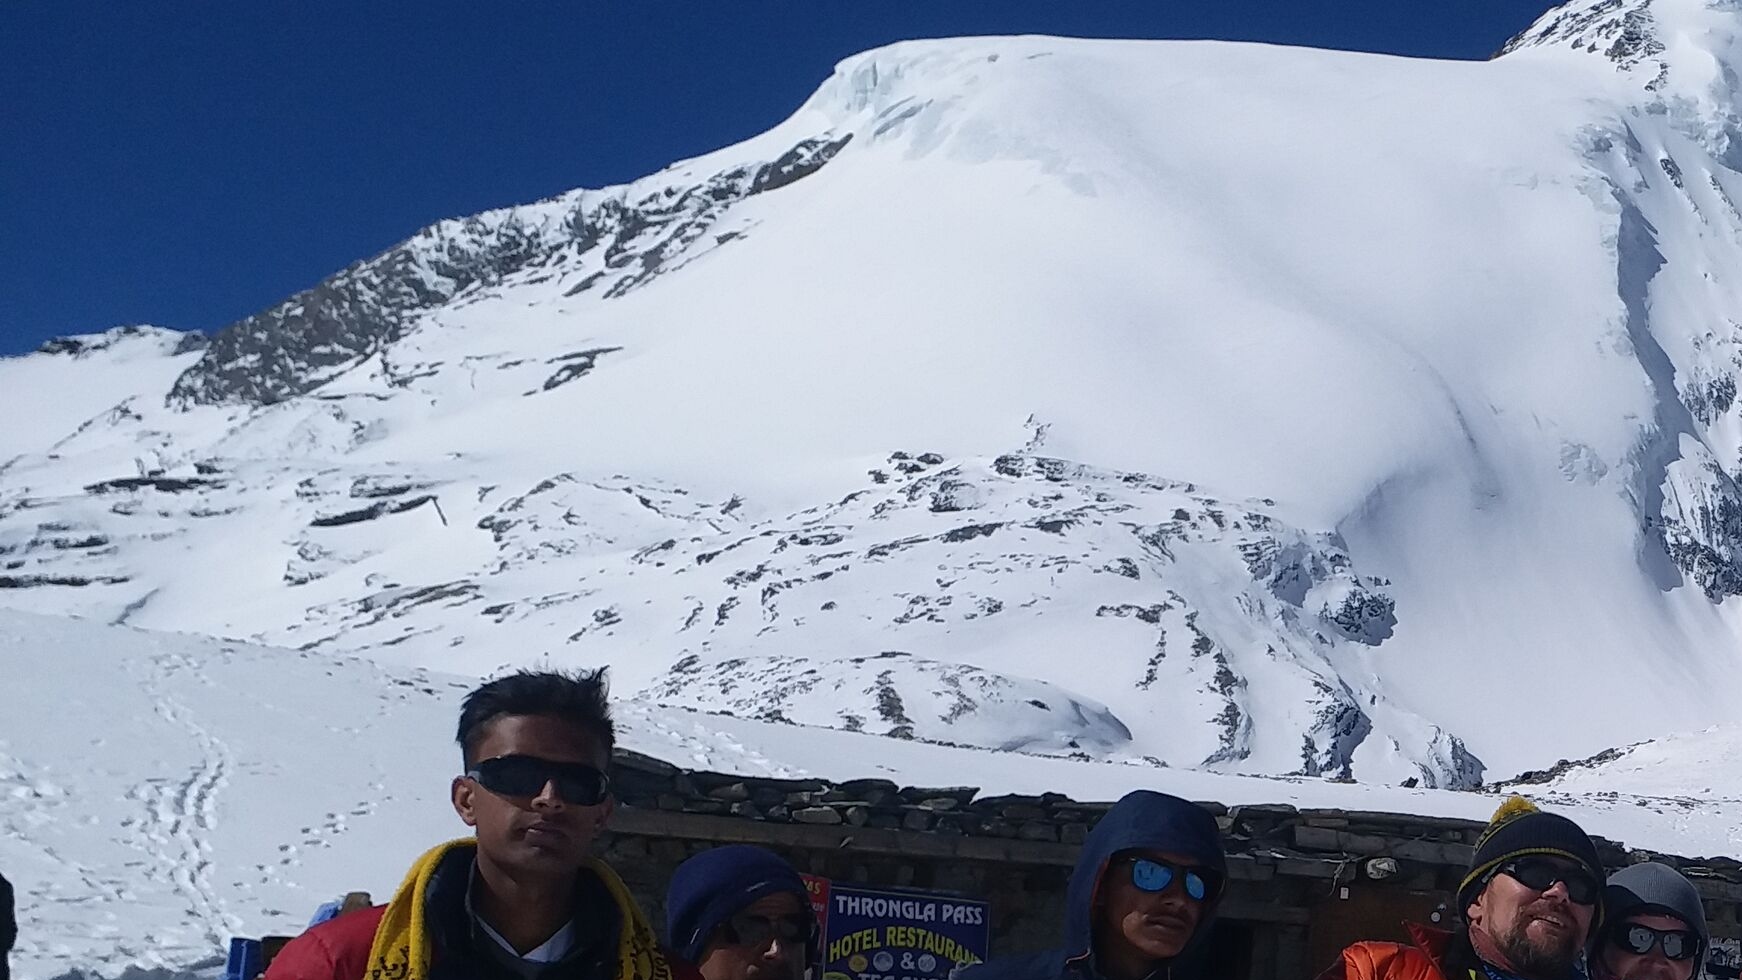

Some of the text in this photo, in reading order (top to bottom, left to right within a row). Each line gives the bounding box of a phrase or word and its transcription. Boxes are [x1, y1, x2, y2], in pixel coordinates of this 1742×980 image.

[835, 895, 936, 923] THRONGLA
[942, 903, 983, 925] PASS
[829, 928, 881, 964] HOTEL
[900, 951, 916, 971] &
